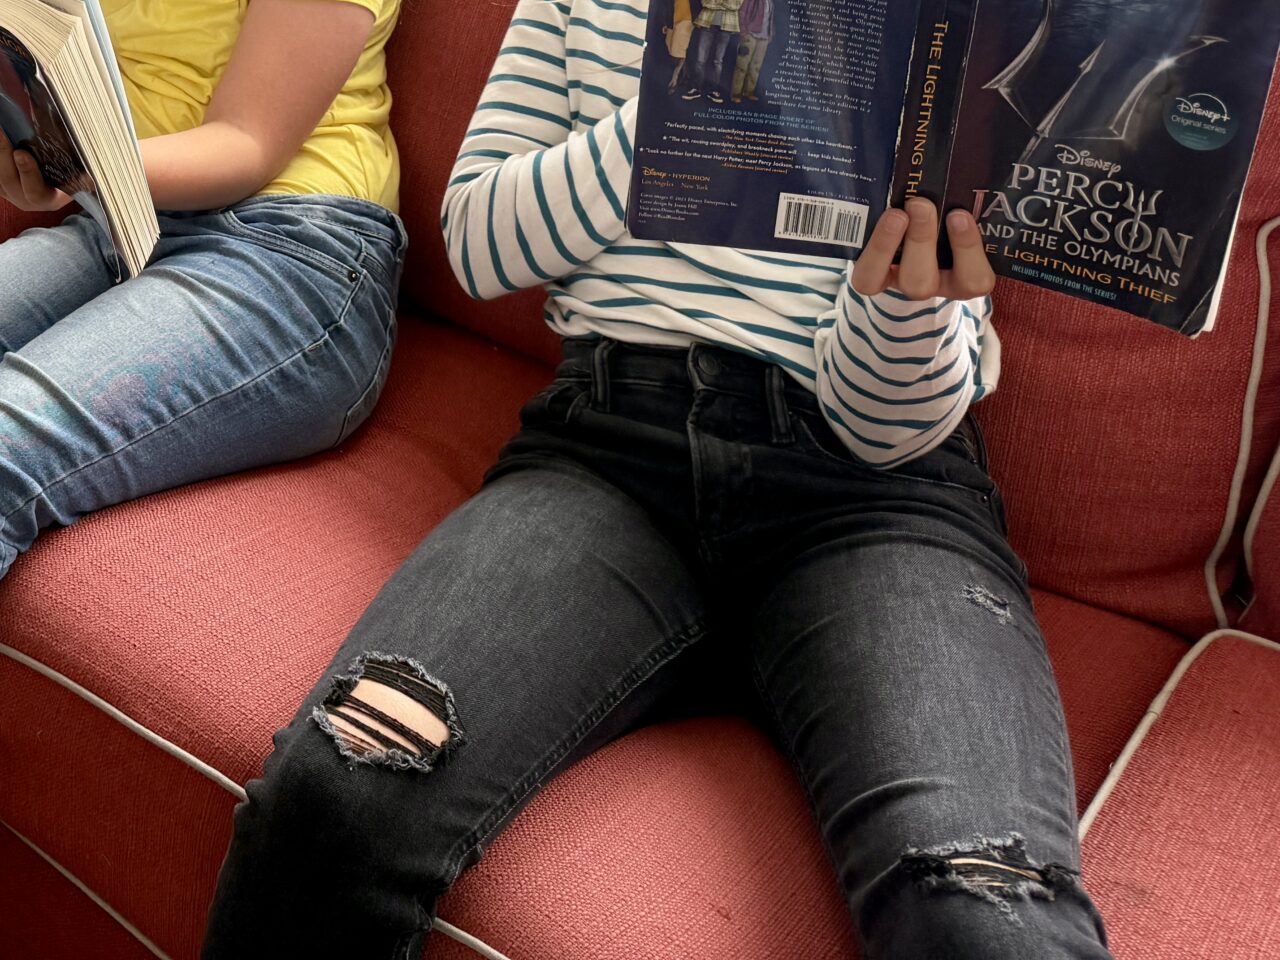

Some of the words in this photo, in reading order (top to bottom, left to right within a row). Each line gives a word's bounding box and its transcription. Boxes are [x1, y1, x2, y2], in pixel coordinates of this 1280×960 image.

[928, 20, 949, 60] THE
[911, 64, 941, 166] LIGHTNING
[1171, 115, 1202, 128] Original
[1203, 124, 1226, 134] series
[672, 172, 711, 181] HYPERION
[1007, 162, 1164, 216] PERCY
[972, 189, 1193, 268] JACKSON
[1003, 245, 1112, 285] LIGHTNING
[1118, 276, 1178, 304] THIEF
[1011, 264, 1039, 278] INCLUDES
[1040, 272, 1063, 285] PHOTOS
[1064, 279, 1081, 291] FROM
[1082, 285, 1093, 295] THE
[1094, 289, 1117, 301] SERIES!
[1020, 228, 1059, 251] THE
[1064, 241, 1181, 287] OLYMPIANS
